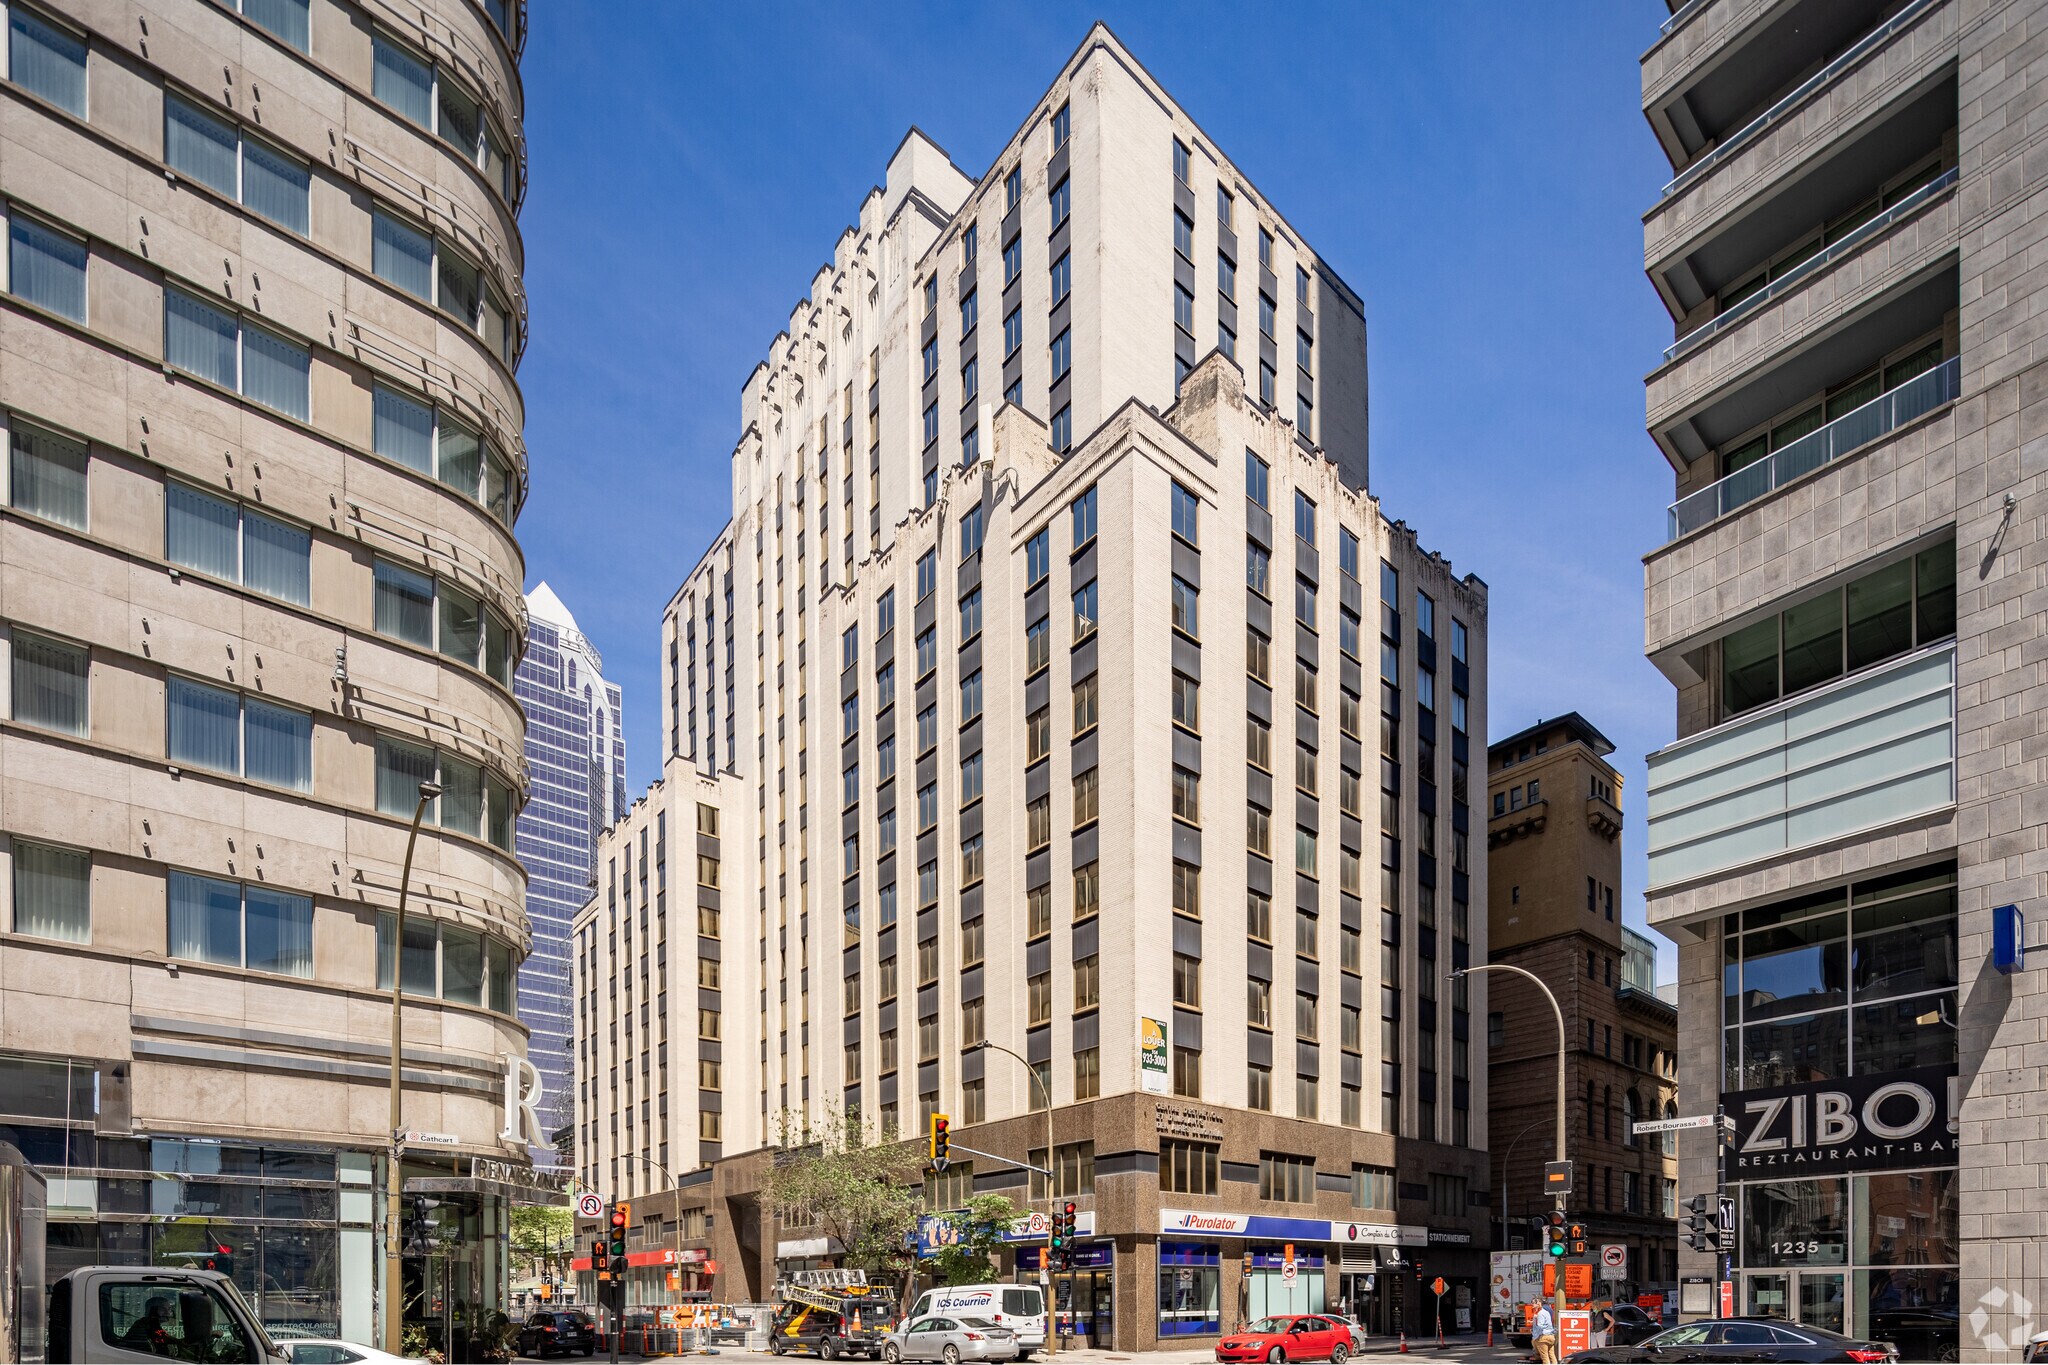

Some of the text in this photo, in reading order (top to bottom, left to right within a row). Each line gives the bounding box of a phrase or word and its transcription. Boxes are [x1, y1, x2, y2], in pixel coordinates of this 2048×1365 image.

[1143, 1036, 1165, 1047] LOUER
[1142, 1052, 1167, 1067] 933-3000
[497, 1051, 558, 1151] R
[1739, 1076, 1959, 1153] ZIBO!
[1636, 1121, 1697, 1132] Robert-Bourassa
[420, 1135, 453, 1143] Cathcart
[1189, 1215, 1237, 1230] Purolator
[1771, 1241, 1819, 1254] 1235
[936, 1296, 991, 1307] ICS Courrier
[1570, 1319, 1579, 1329] P
